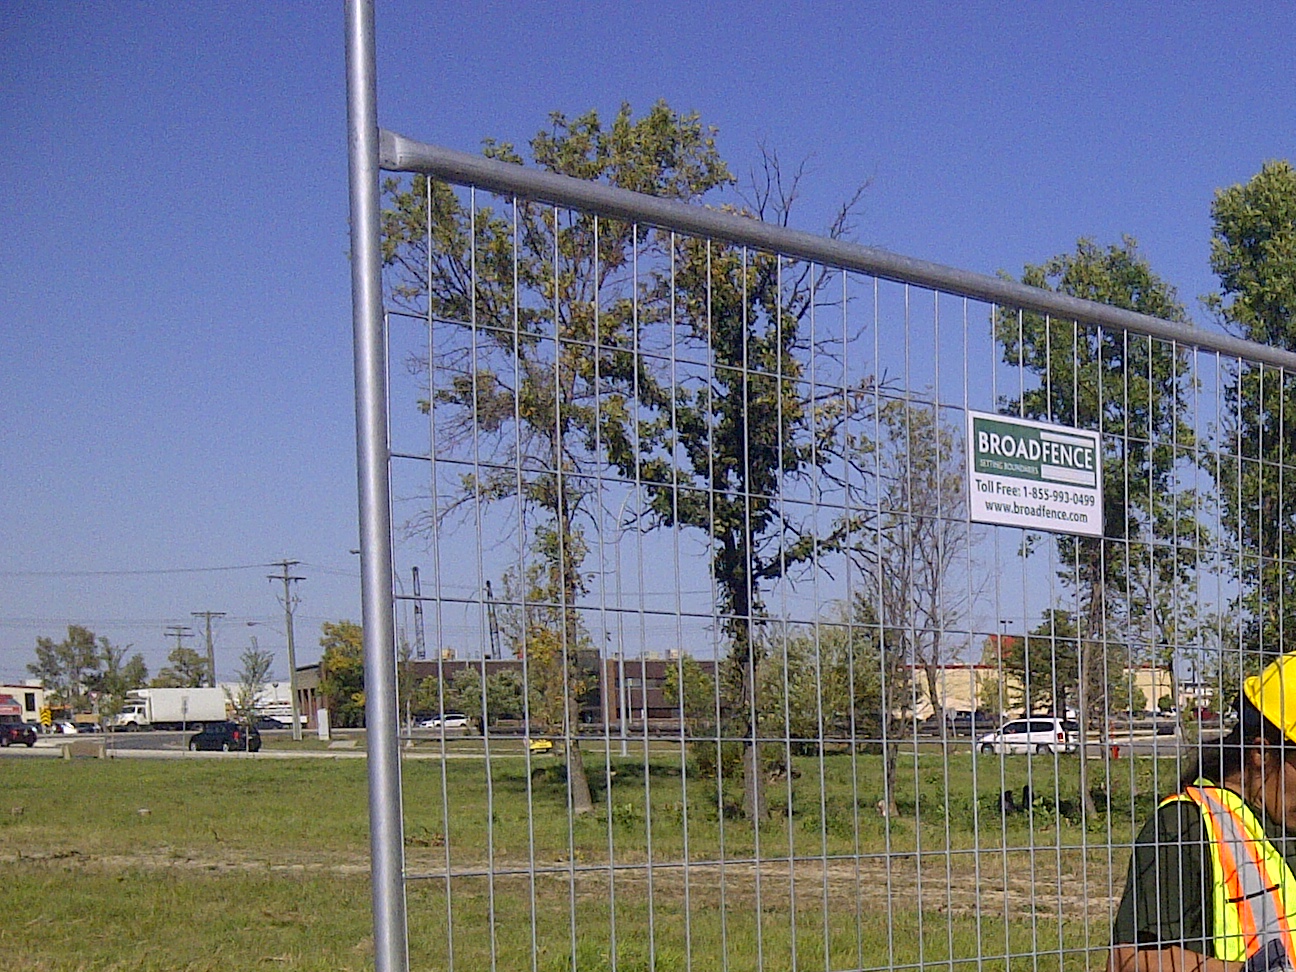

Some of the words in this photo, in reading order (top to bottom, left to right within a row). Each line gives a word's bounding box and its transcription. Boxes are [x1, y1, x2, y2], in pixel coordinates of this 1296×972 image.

[978, 431, 1093, 470] BROADFENCE
[975, 479, 993, 492] Toll
[996, 482, 1021, 497] Free:
[1023, 486, 1095, 507] 1-855-993-0499
[984, 501, 1088, 523] www.broadfence.com
